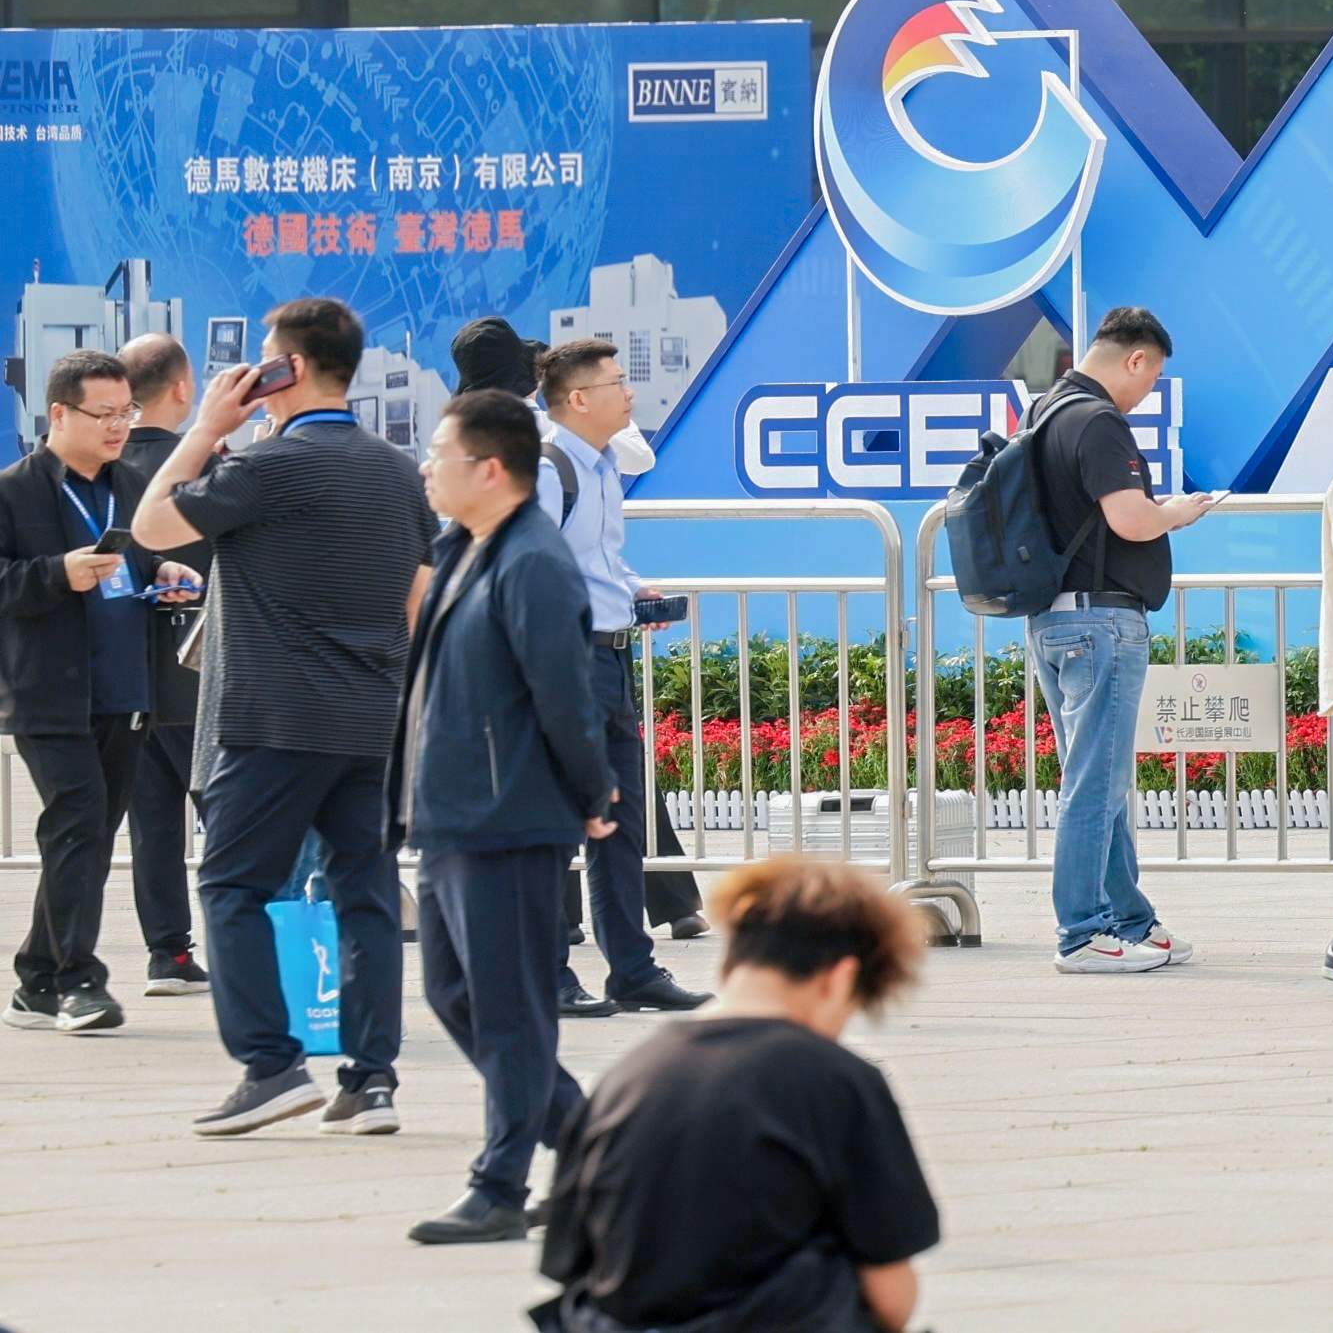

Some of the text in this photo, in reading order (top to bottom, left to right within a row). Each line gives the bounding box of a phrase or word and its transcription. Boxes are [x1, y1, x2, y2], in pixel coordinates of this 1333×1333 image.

[636, 79, 711, 106] BINNE
[36, 124, 82, 141] 台湾品质
[243, 208, 526, 256] 德國技術 臺灣德馬
[1156, 695, 1250, 723] 禁止攀爬
[1177, 727, 1251, 738] 长沙国际会展中心
